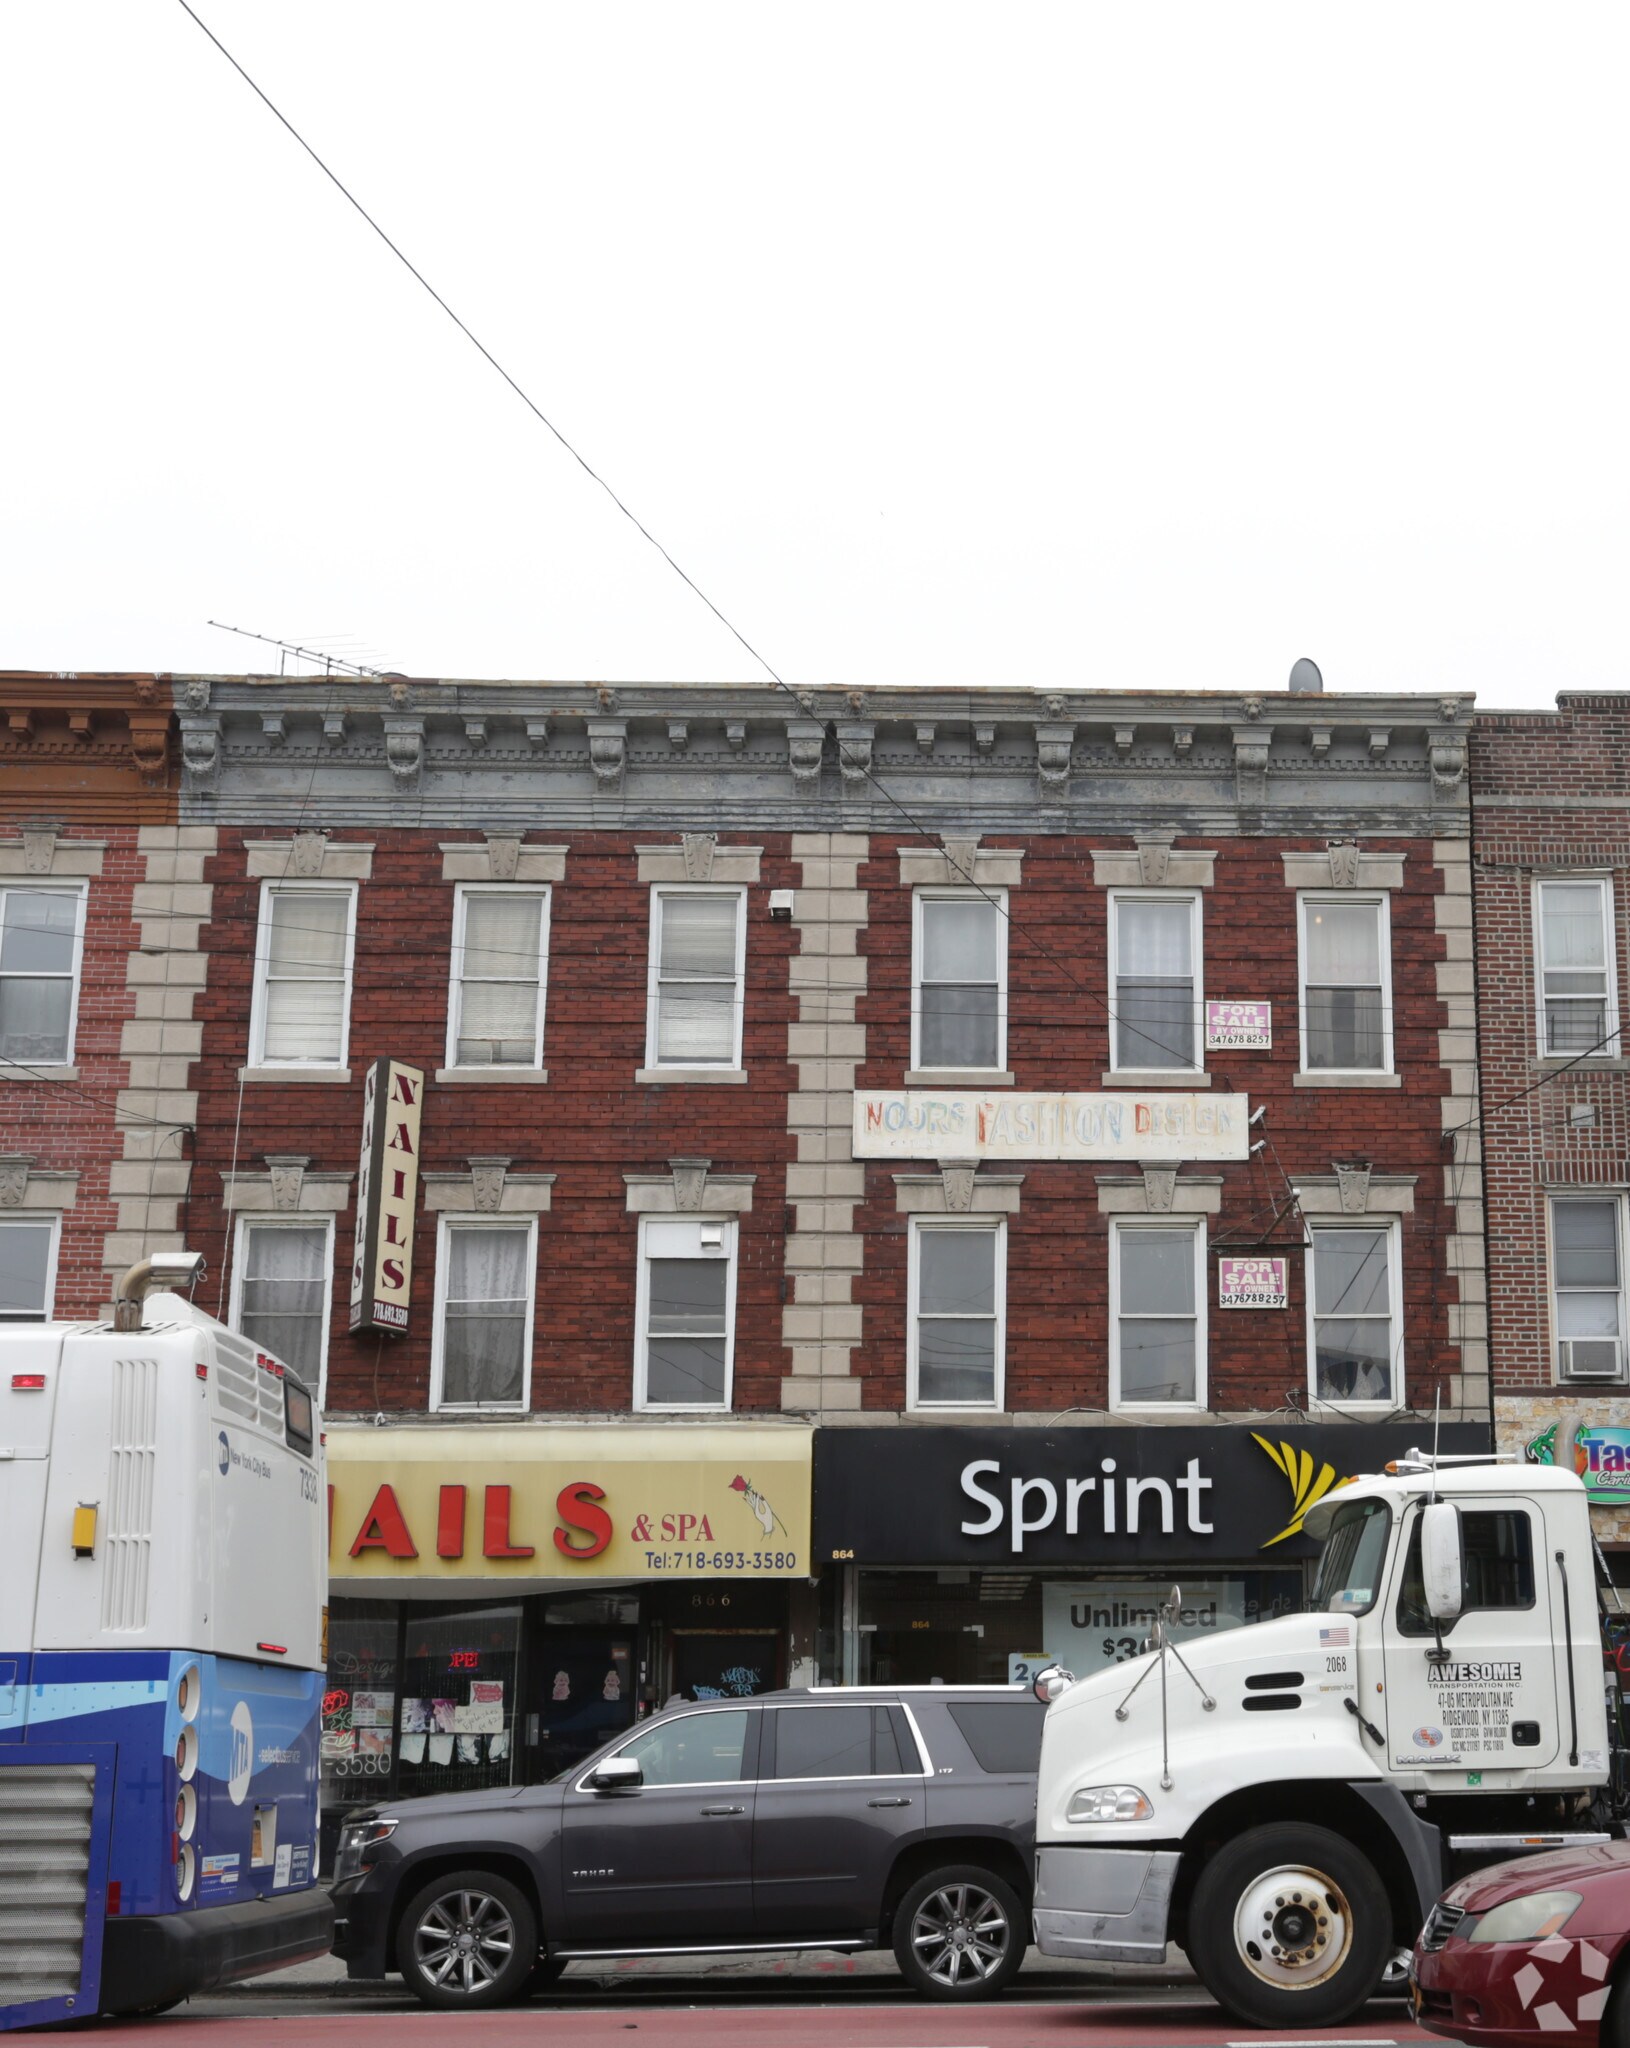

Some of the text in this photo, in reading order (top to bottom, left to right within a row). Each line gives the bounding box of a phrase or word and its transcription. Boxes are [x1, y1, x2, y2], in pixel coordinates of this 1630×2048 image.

[1219, 1005, 1258, 1016] FOR
[1211, 1016, 1266, 1027] SALE
[1216, 1027, 1261, 1035] BY OWNER
[974, 1100, 1124, 1147] FASHION
[1134, 1101, 1232, 1137] DESIGN
[381, 1071, 420, 1290] NAILS
[1232, 1262, 1273, 1273] FOR
[1225, 1273, 1281, 1285] SALE
[1229, 1285, 1276, 1293] BY OWNER
[230, 1448, 272, 1480] New York City Bus
[960, 1457, 1214, 1552] Sprint
[328, 1481, 614, 1559] AILS
[630, 1513, 716, 1543] & SPA
[645, 1551, 797, 1570] Tel:718-693-3580
[831, 1549, 855, 1560] 864
[691, 1593, 731, 1608] 866
[1070, 1602, 1217, 1630] Unlimed
[911, 1620, 930, 1630] 864
[449, 1652, 479, 1669] PE
[1325, 1655, 1347, 1673] 2068
[1427, 1662, 1522, 1682] AWESOME
[1428, 1681, 1523, 1690] TRANSPORTATION INC.
[1437, 1691, 1514, 1709] 47-05 METROPOLITAN AVE
[1482, 1709, 1491, 1725] NY
[1395, 1754, 1462, 1765] MACK
[572, 1868, 615, 1877] TAHOE
